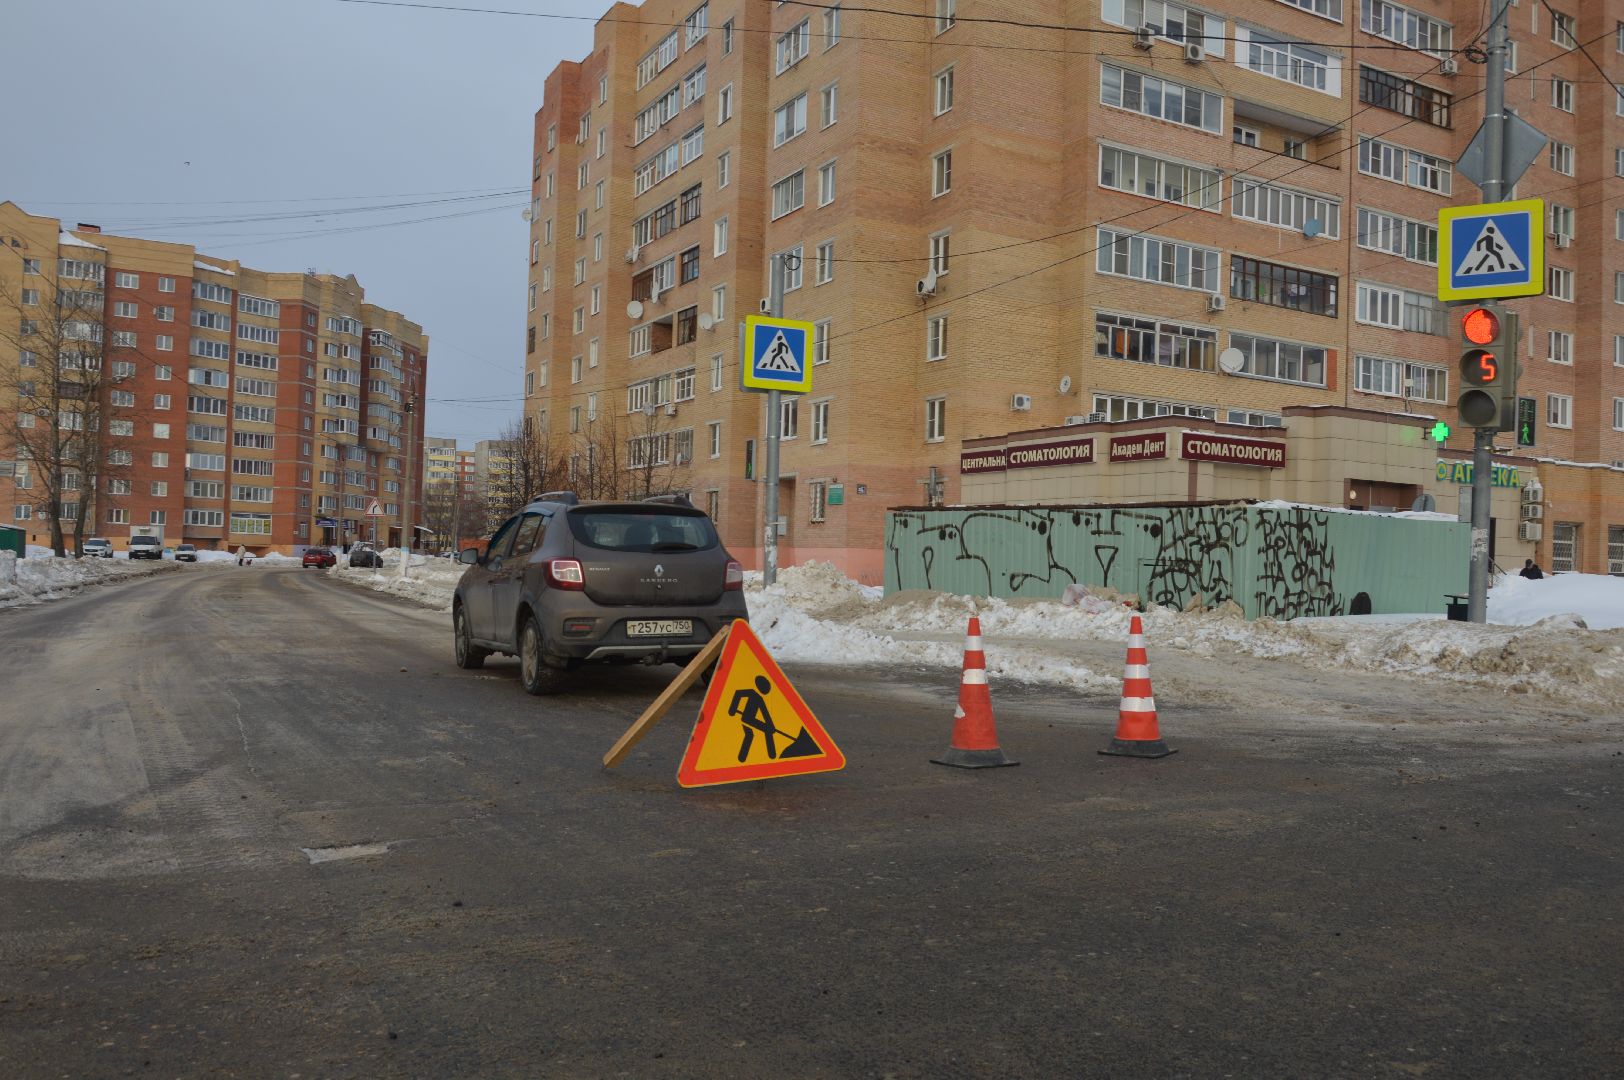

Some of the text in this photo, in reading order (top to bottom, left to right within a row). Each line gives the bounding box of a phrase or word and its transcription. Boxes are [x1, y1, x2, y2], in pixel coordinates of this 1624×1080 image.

[1481, 354, 1495, 381] 5
[1009, 444, 1090, 464] СТОМАТОЛОГИЯ
[1111, 439, 1165, 457] Академ Дент
[1187, 440, 1283, 462] СТОМАТОЛОГИЯ
[962, 455, 1007, 471] ЦЕНТРАЛЬНА
[1452, 462, 1520, 487] АПЕКА
